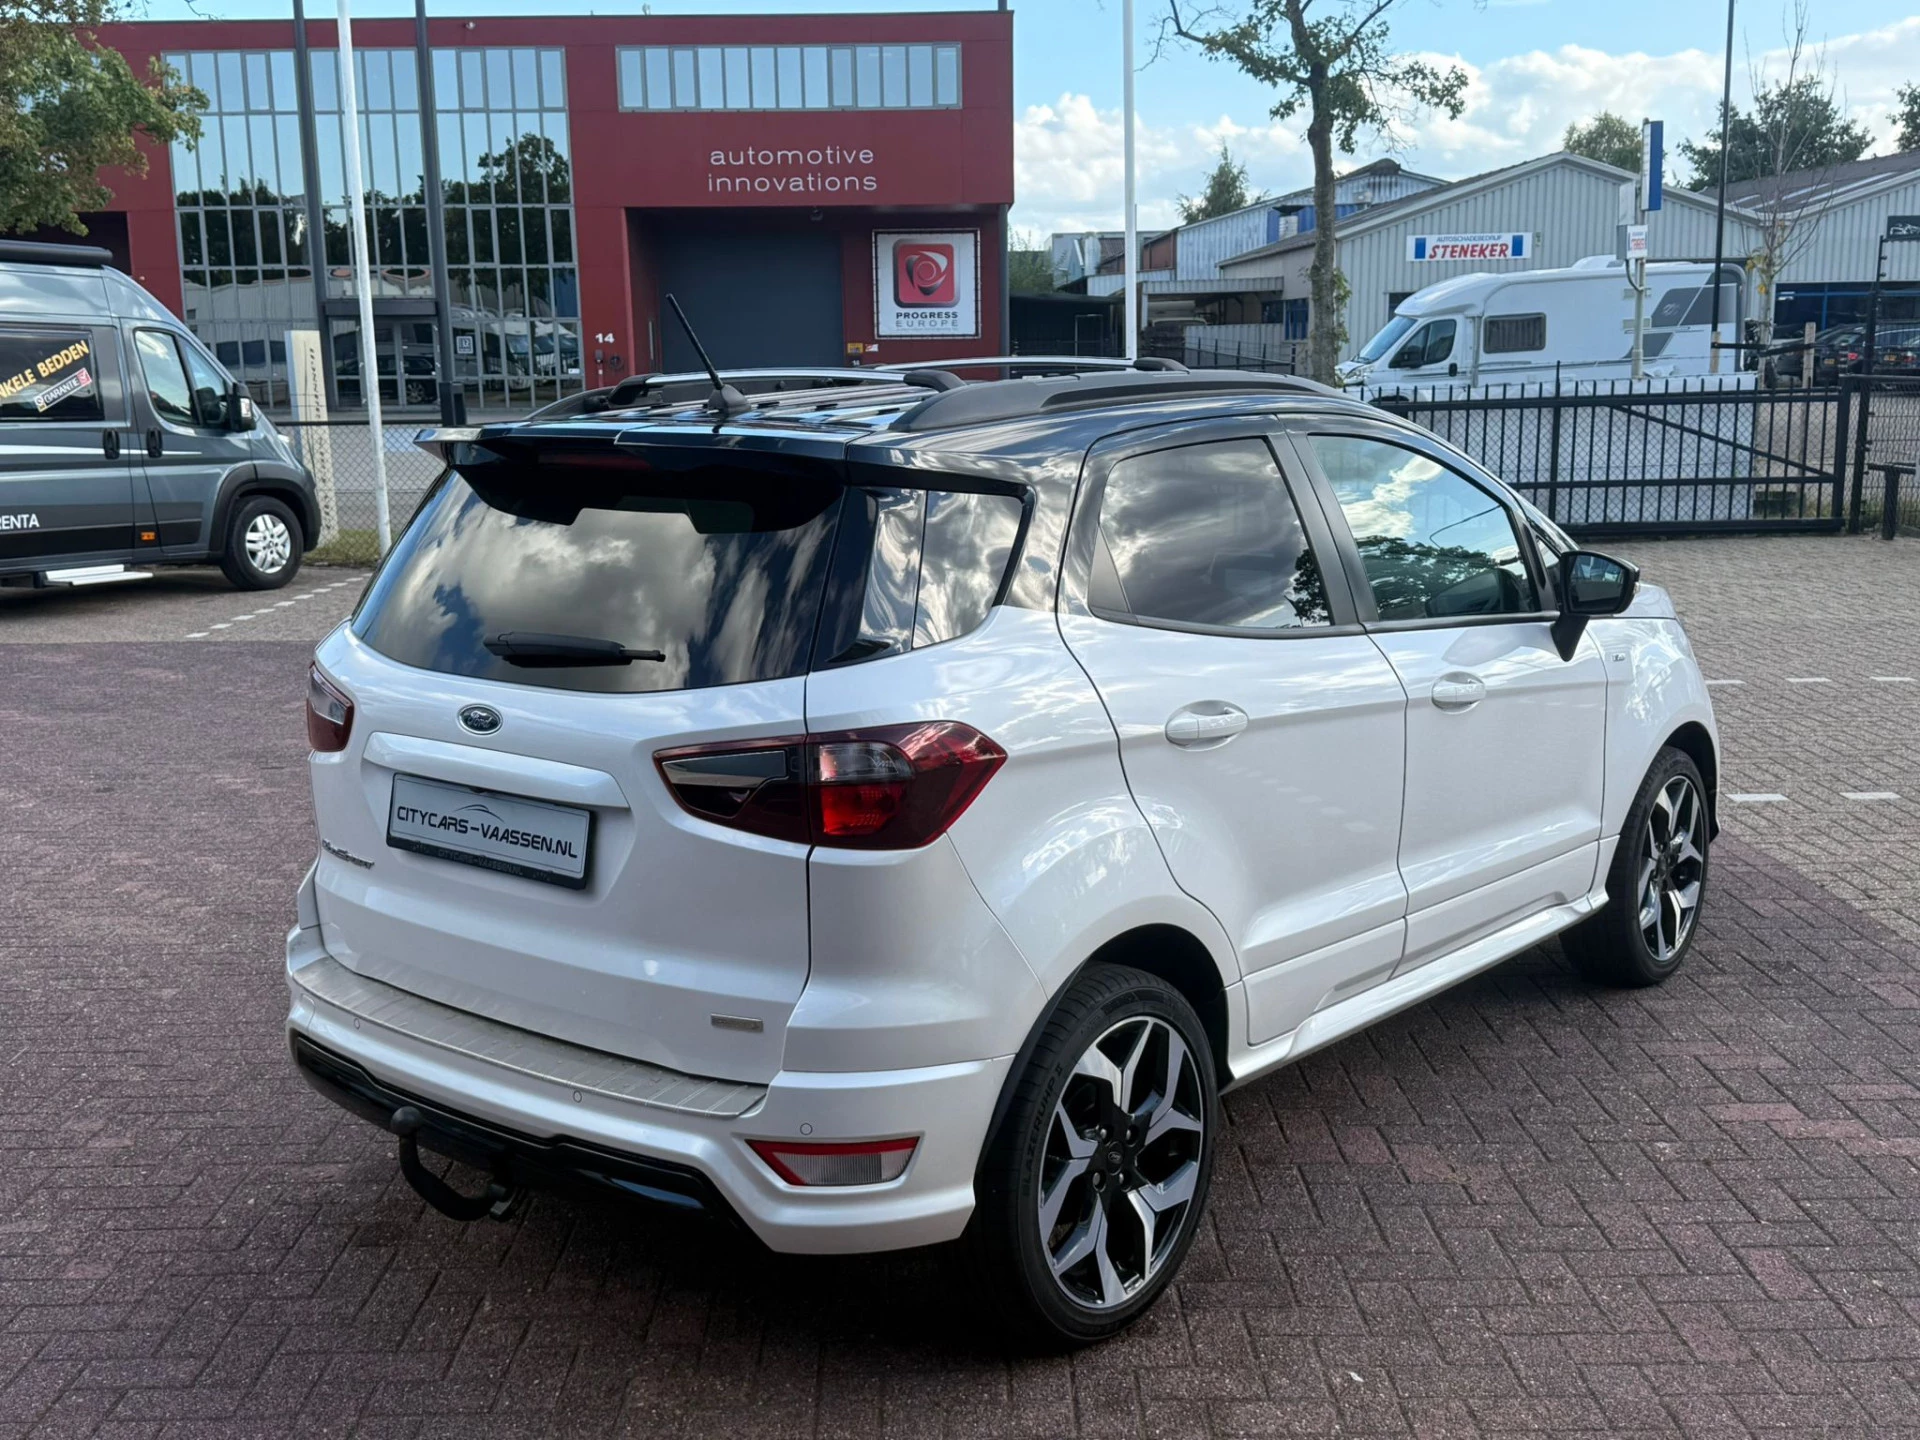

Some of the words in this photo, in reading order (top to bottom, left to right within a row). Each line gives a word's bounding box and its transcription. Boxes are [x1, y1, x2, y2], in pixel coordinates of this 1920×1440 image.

[710, 146, 874, 165] automotive
[708, 173, 877, 192] innovations
[1429, 243, 1509, 259] STENEKER
[896, 311, 958, 319] PROGRESS
[595, 333, 615, 343] 14
[36, 339, 90, 378] BEDDEN
[43, 377, 80, 403] GARANTIE
[0, 513, 40, 530] ENTA
[397, 806, 578, 859] CITYCARS-VAASSEN.NL
